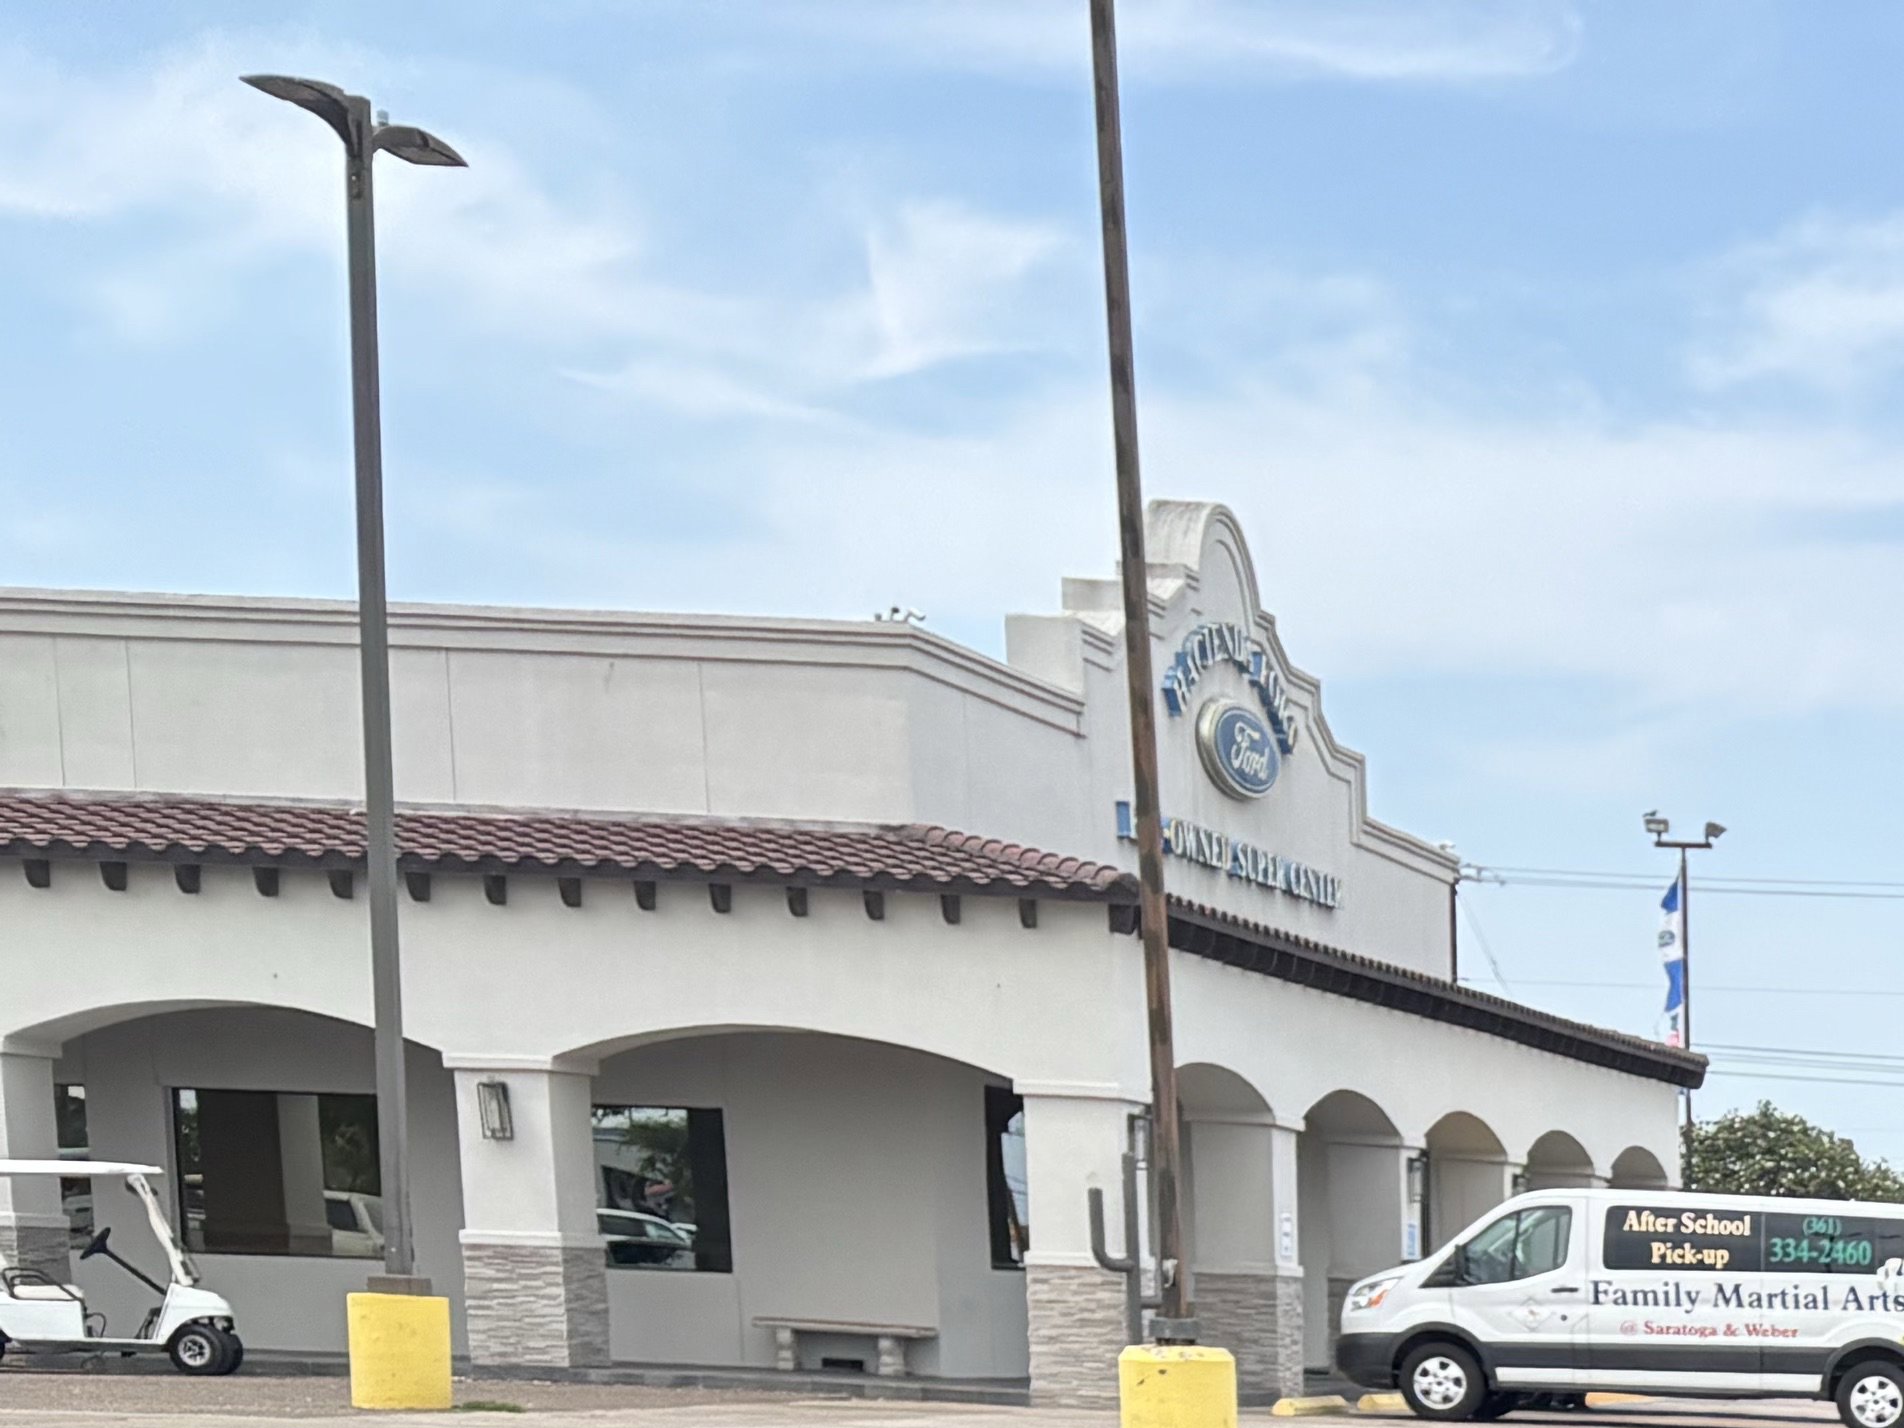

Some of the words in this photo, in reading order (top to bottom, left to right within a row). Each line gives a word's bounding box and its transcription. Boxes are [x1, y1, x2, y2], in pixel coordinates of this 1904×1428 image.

[1230, 720, 1271, 781] Ford
[1623, 1210, 1677, 1234] After
[1680, 1212, 1751, 1236] School
[1802, 1217, 1843, 1236] (361)
[1650, 1242, 1730, 1269] Pick-up
[1768, 1237, 1874, 1266] 334-2460
[1590, 1279, 1702, 1314] Family
[1713, 1282, 1830, 1312] Martial
[1643, 1320, 1719, 1338] Saratoga
[1722, 1322, 1741, 1337] &
[1745, 1322, 1801, 1339] Weber
